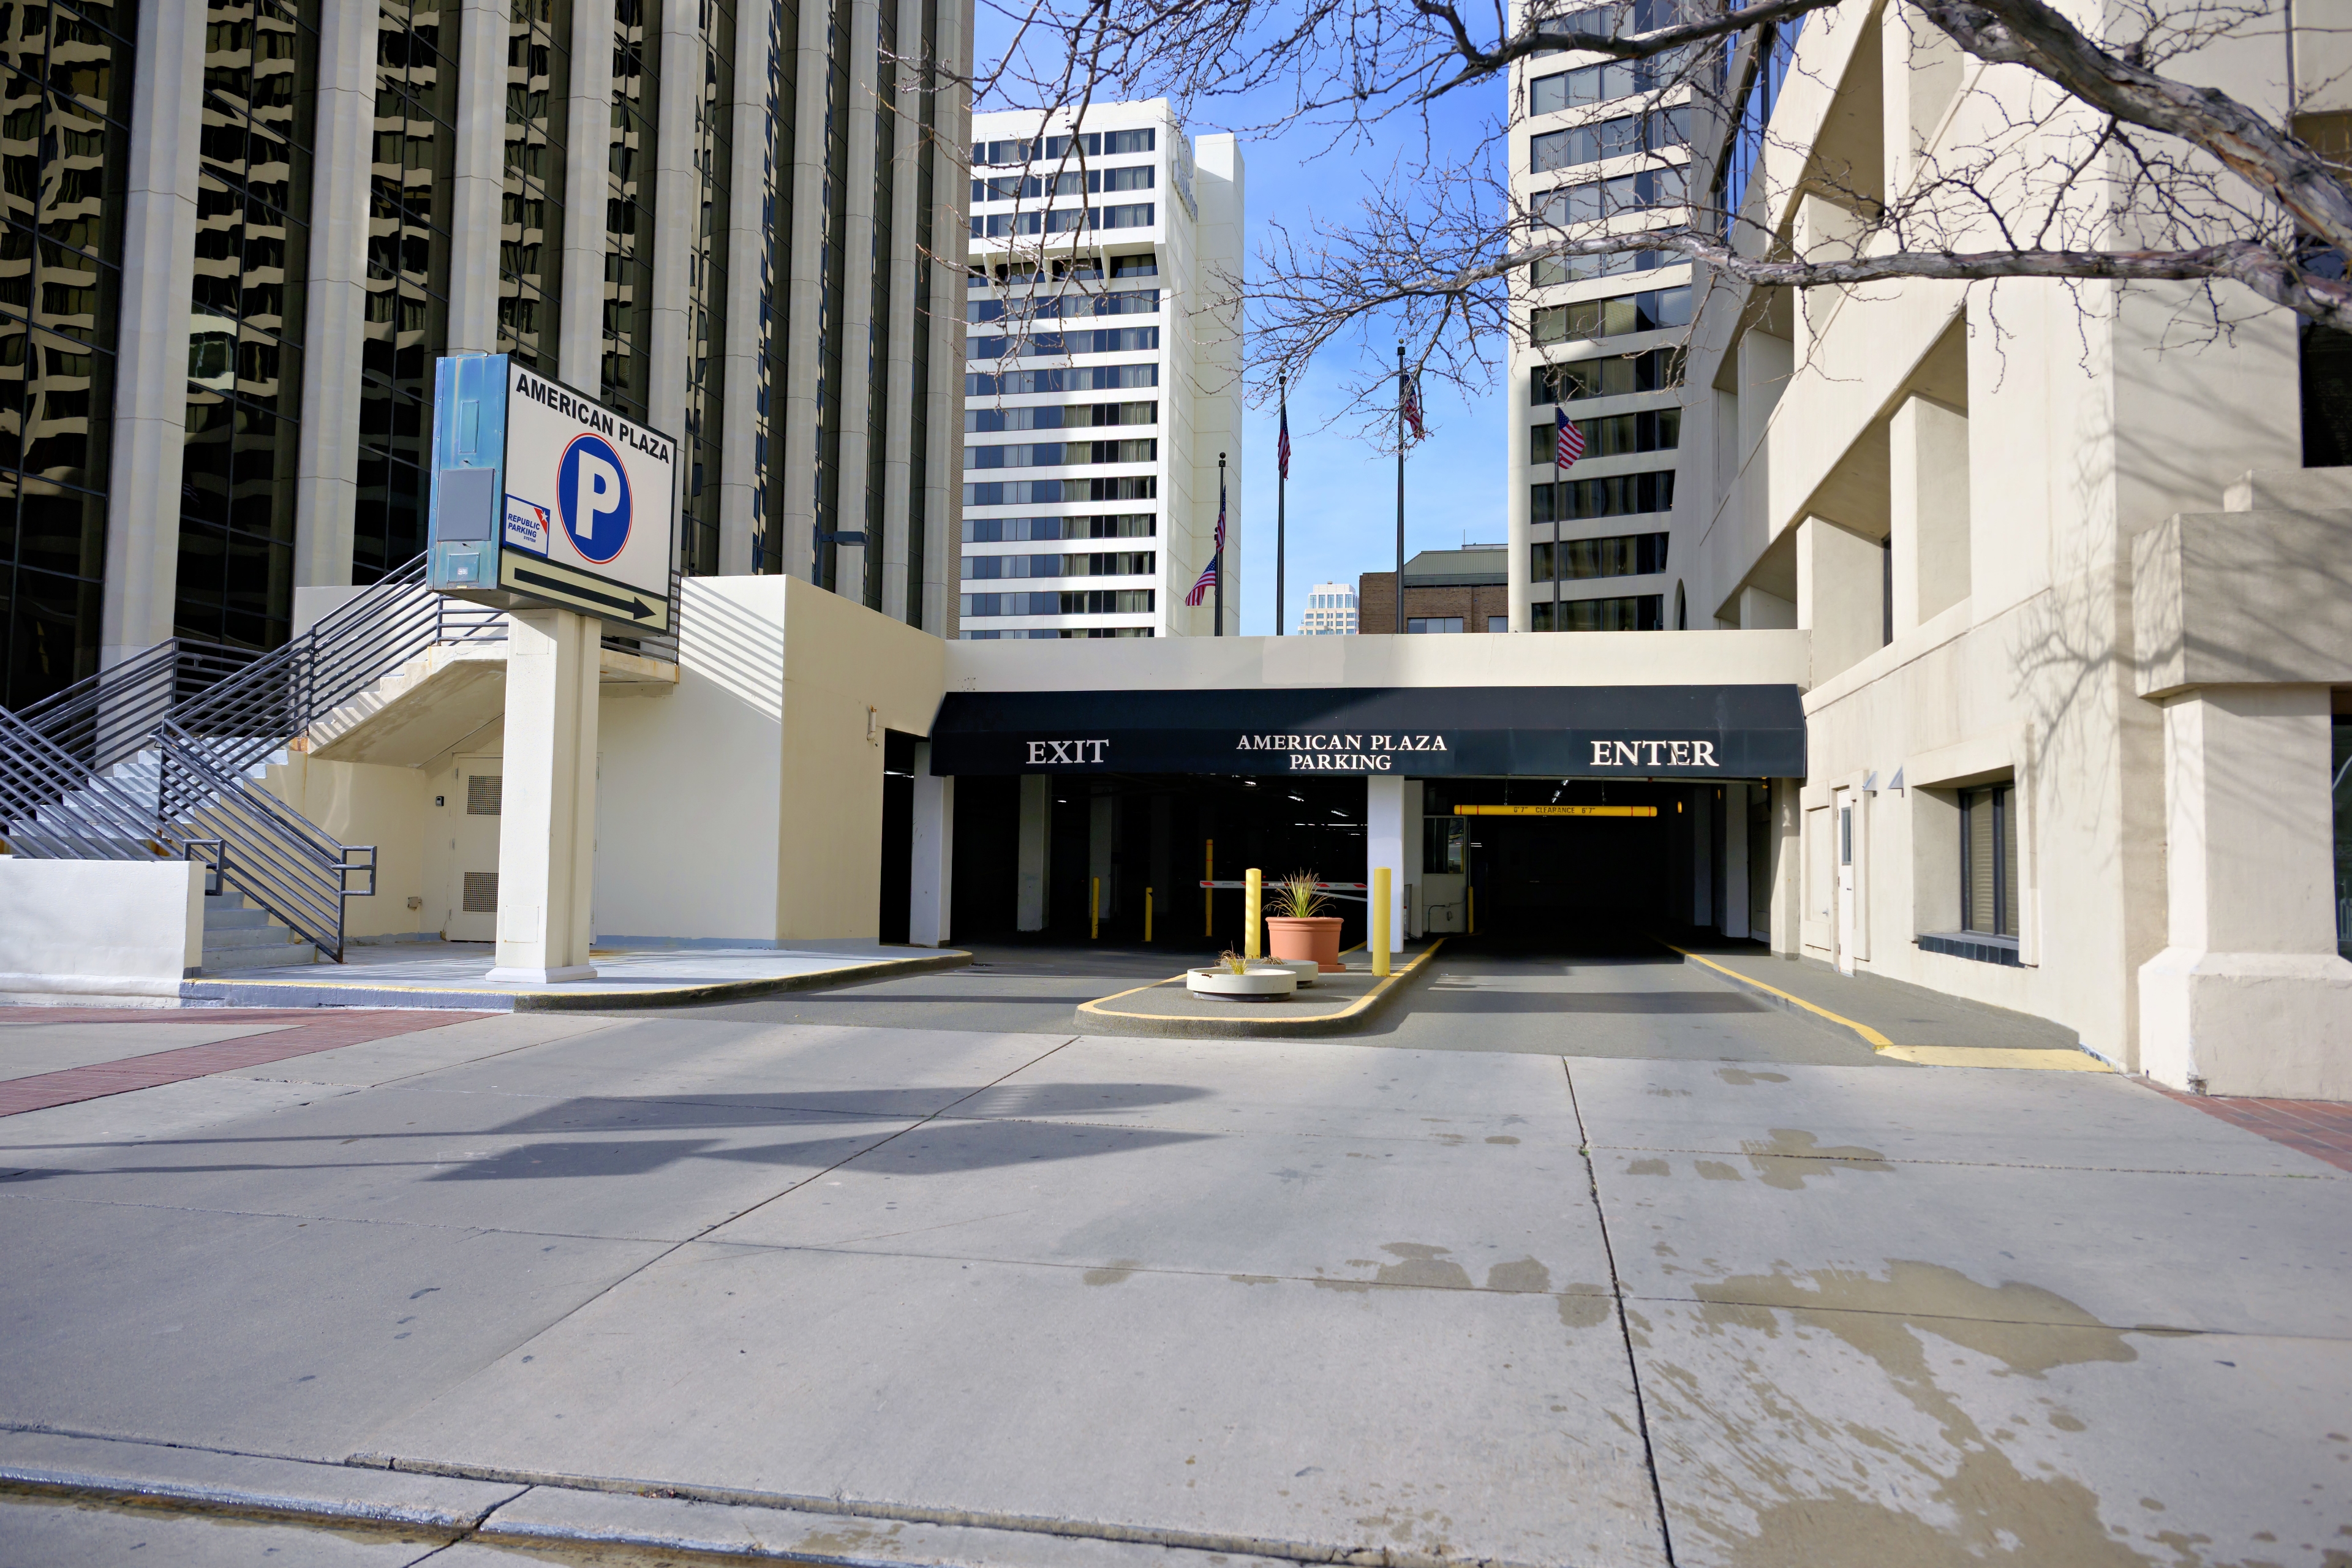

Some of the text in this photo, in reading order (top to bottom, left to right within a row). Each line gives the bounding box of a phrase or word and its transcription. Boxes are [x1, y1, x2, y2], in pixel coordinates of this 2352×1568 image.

[516, 373, 669, 464] AMERICAN PLAZA
[575, 449, 621, 540] P
[508, 513, 540, 530] REPUBLIC
[508, 522, 537, 538] PARKING
[1025, 739, 1109, 764] EXIT
[1236, 734, 1447, 751] AMERICAN PLAZA
[1289, 754, 1392, 771] PARKING
[1589, 740, 1720, 767] ENTER
